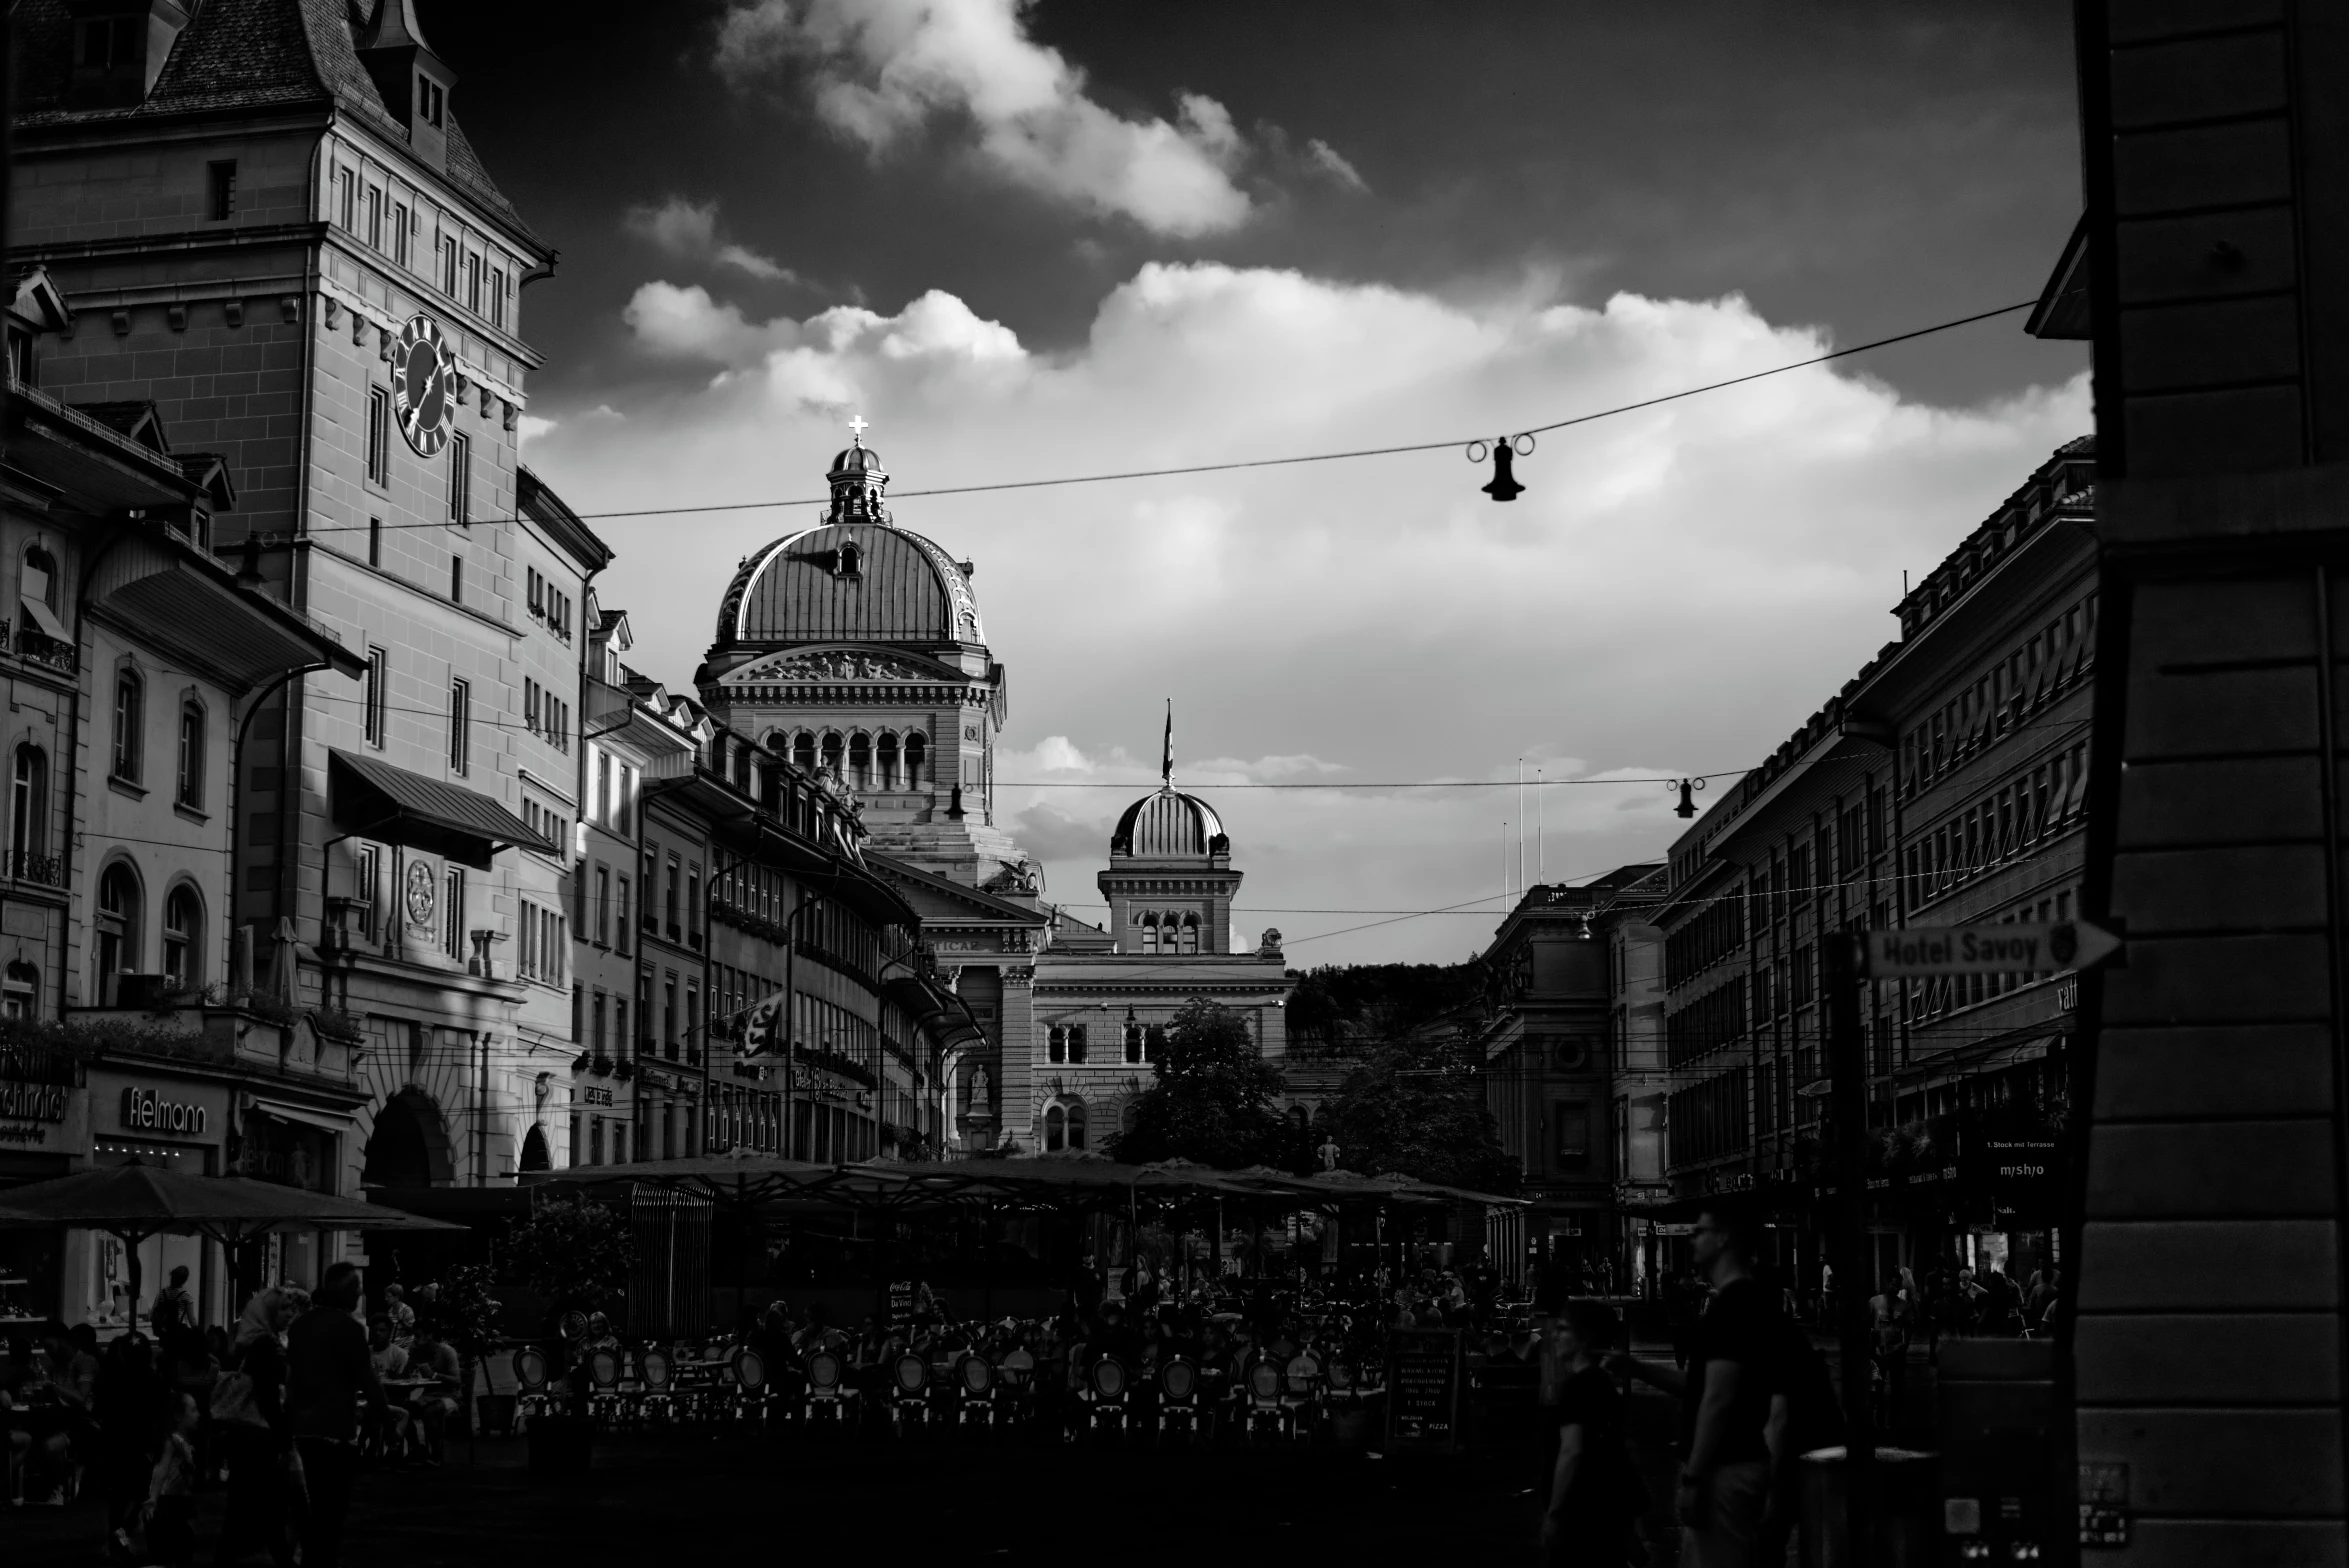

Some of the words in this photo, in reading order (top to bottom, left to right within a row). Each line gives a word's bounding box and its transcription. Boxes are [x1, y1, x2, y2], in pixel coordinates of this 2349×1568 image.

[1883, 934, 1952, 966] Hotel
[1961, 931, 2039, 968] Savoy
[130, 1086, 206, 1134] fielmann
[1993, 1141, 2013, 1149] Stock
[1416, 1399, 1436, 1407] STOCK
